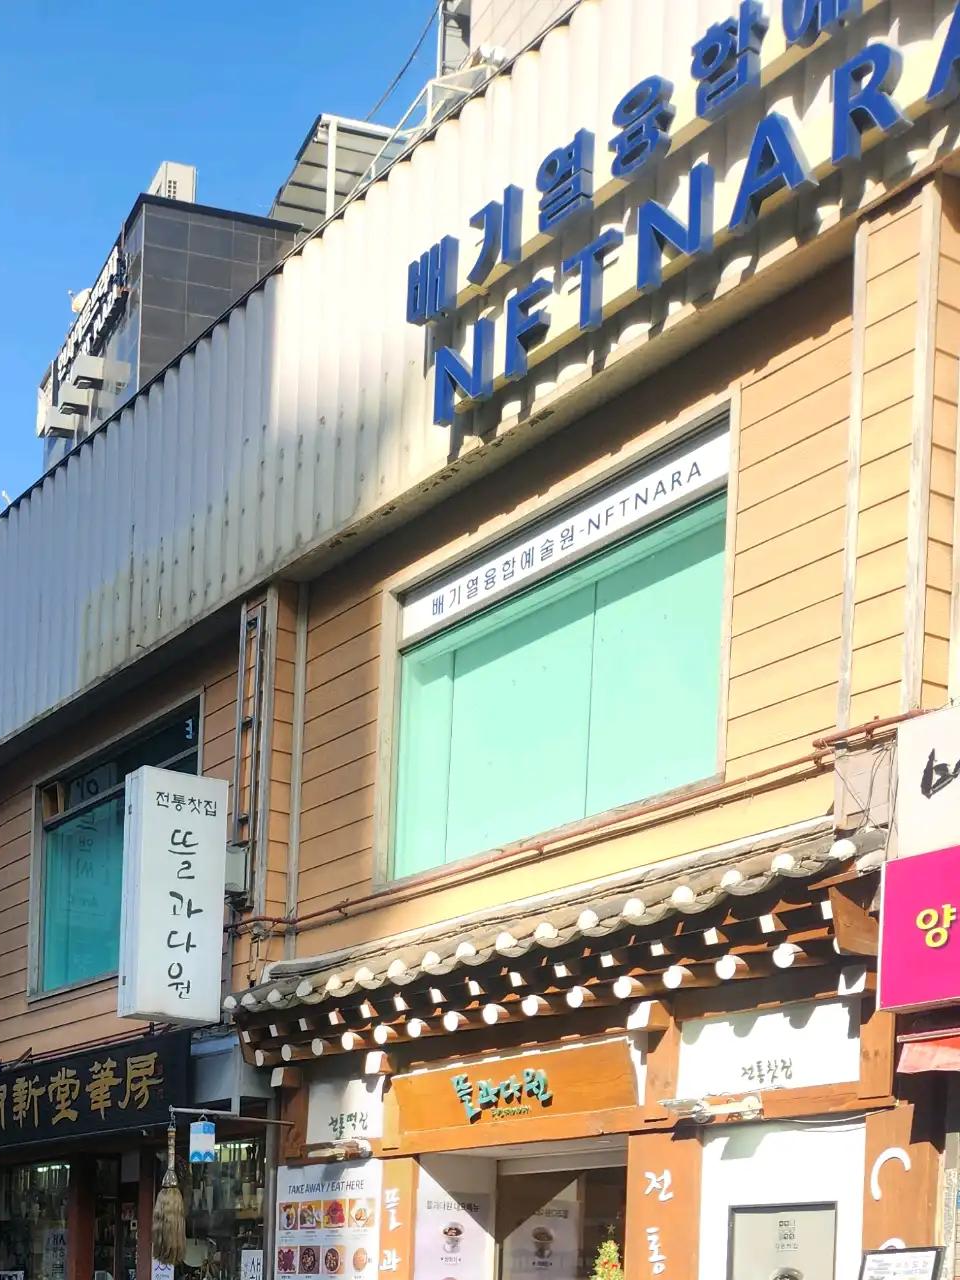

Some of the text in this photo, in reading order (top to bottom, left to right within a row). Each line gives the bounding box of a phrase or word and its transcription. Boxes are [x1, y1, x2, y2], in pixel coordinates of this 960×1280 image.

[155, 791, 217, 816] 전통찻집
[168, 829, 203, 1000] 뜰과다원
[916, 903, 957, 948] 양
[331, 1181, 345, 1191] EAT
[346, 1179, 364, 1189] HERE
